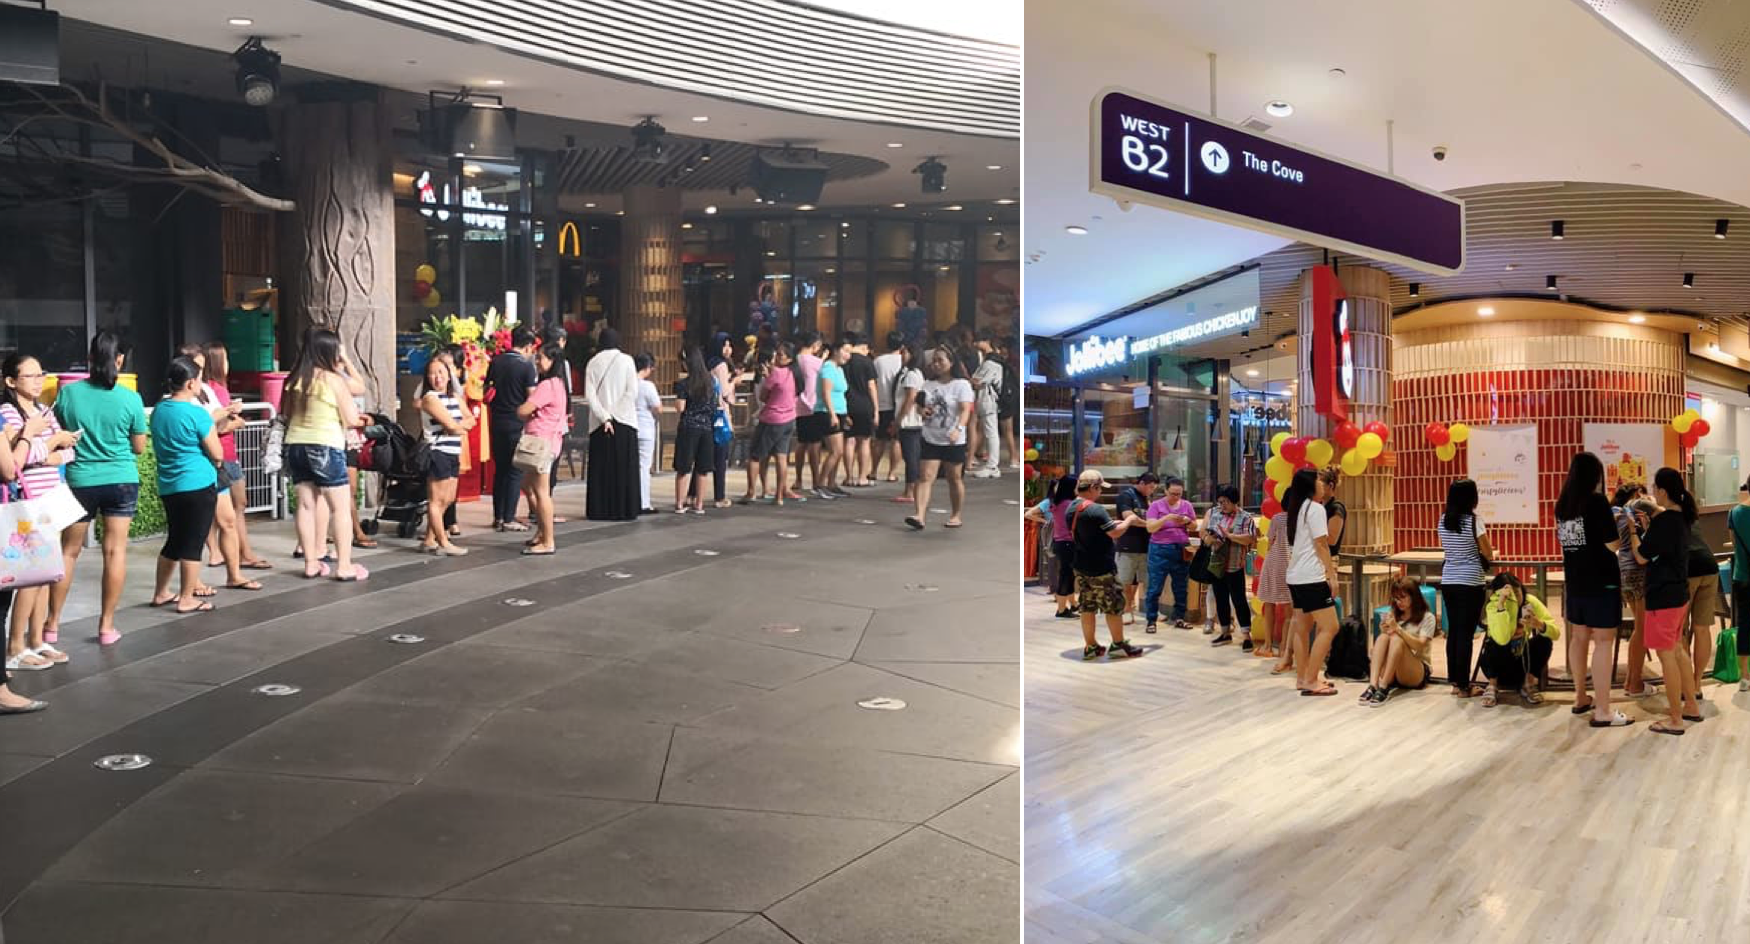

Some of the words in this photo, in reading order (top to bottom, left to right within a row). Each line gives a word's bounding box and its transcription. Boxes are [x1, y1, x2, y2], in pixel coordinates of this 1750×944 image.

[1120, 113, 1171, 141] WEST
[1122, 135, 1169, 178] B2
[1242, 150, 1268, 172] The
[1272, 160, 1304, 183] Cove
[1150, 337, 1160, 351] OF
[1173, 323, 1203, 344] FAMOUS
[1204, 306, 1258, 335] CHICKENJOY
[1065, 334, 1126, 376] Jollibee
